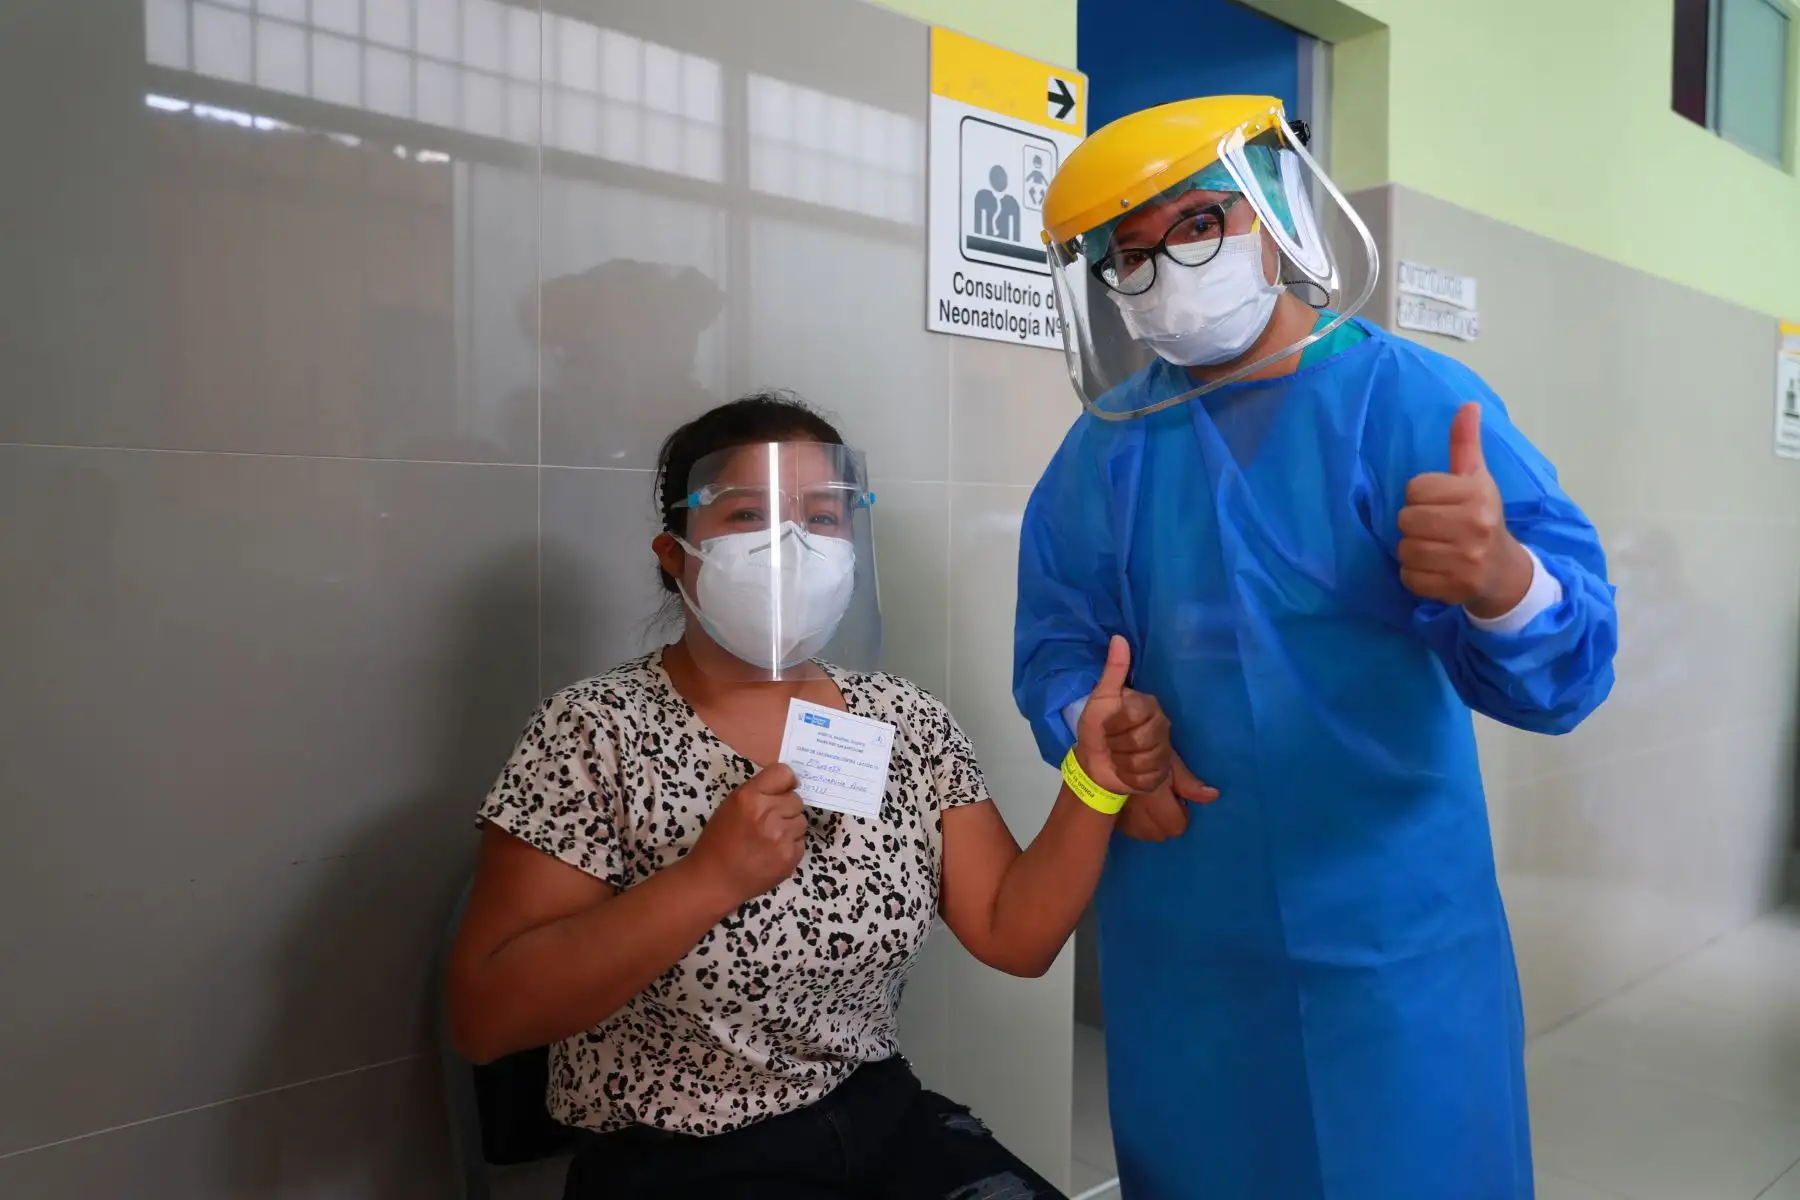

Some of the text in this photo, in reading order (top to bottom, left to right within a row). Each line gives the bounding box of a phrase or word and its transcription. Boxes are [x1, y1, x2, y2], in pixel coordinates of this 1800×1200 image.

[953, 271, 1055, 310] Consultorio d
[940, 299, 1040, 339] Neonatología
